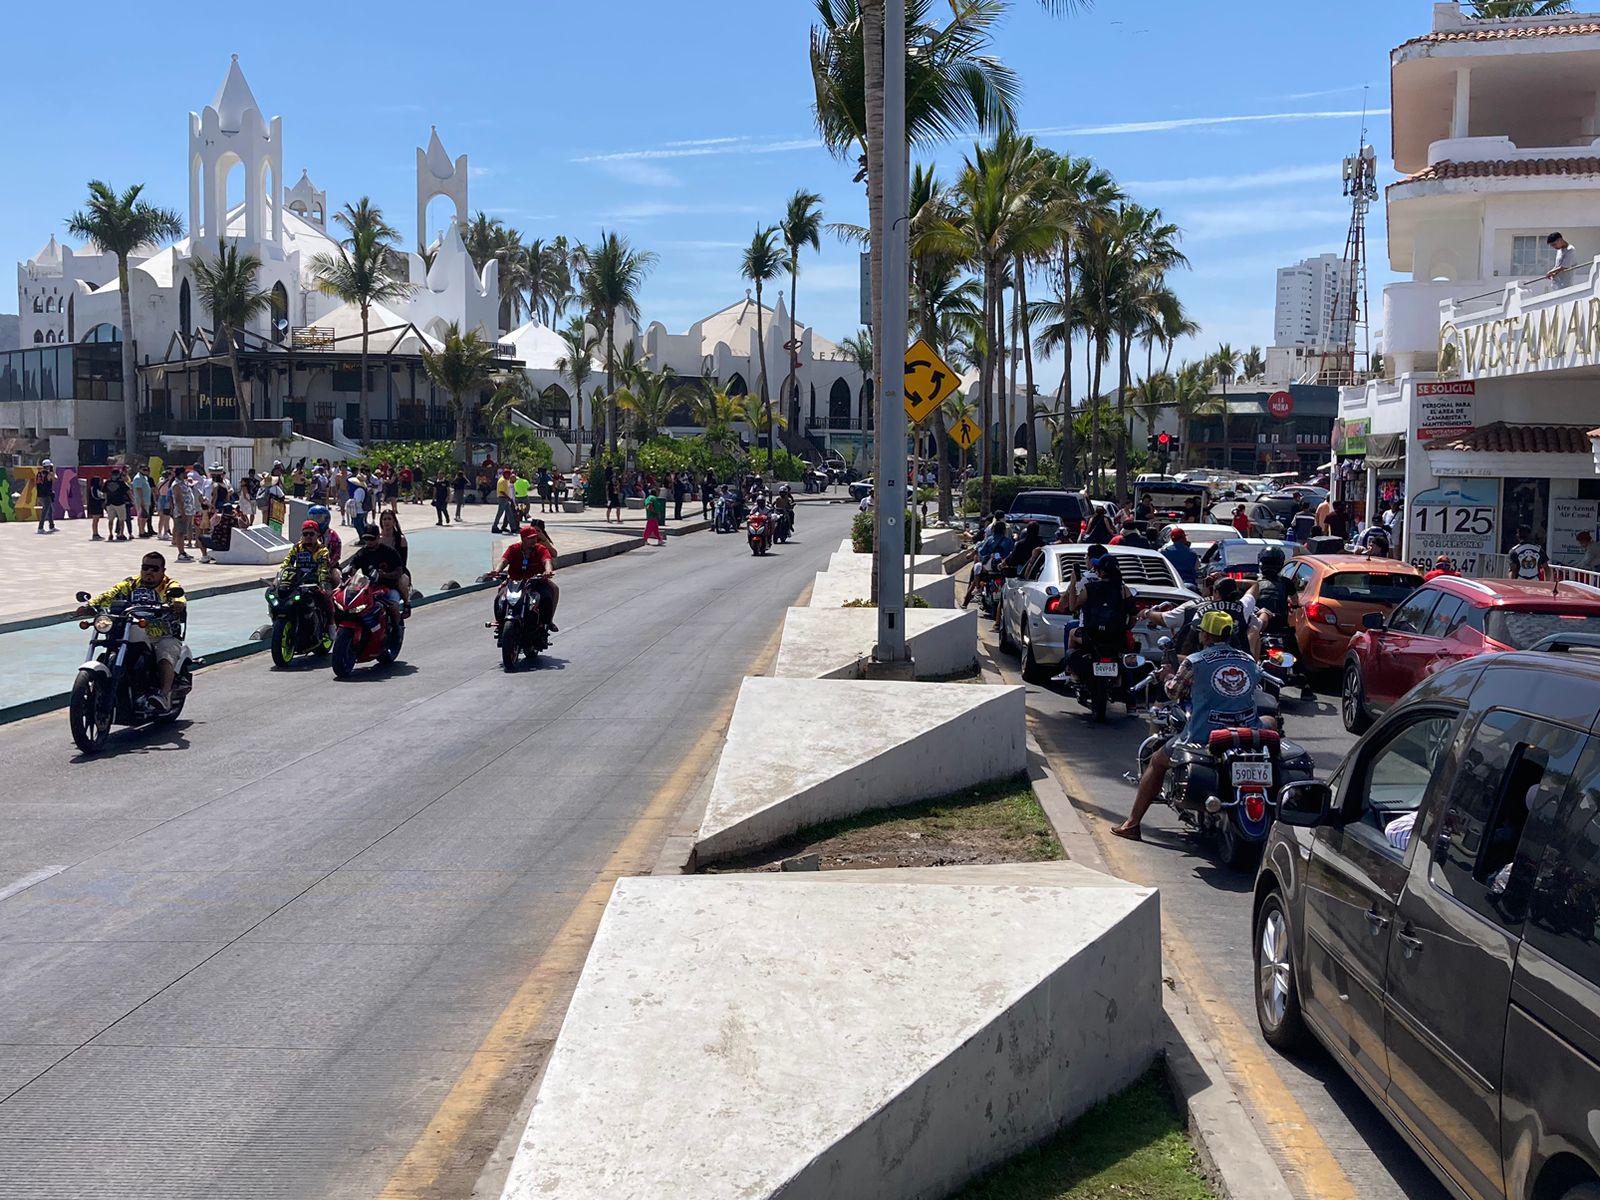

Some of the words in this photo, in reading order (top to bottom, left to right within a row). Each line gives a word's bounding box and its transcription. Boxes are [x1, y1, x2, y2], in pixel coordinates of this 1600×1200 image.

[1418, 385, 1429, 394] SE
[1431, 383, 1473, 393] SOLICITA
[1415, 507, 1493, 535] 1125
